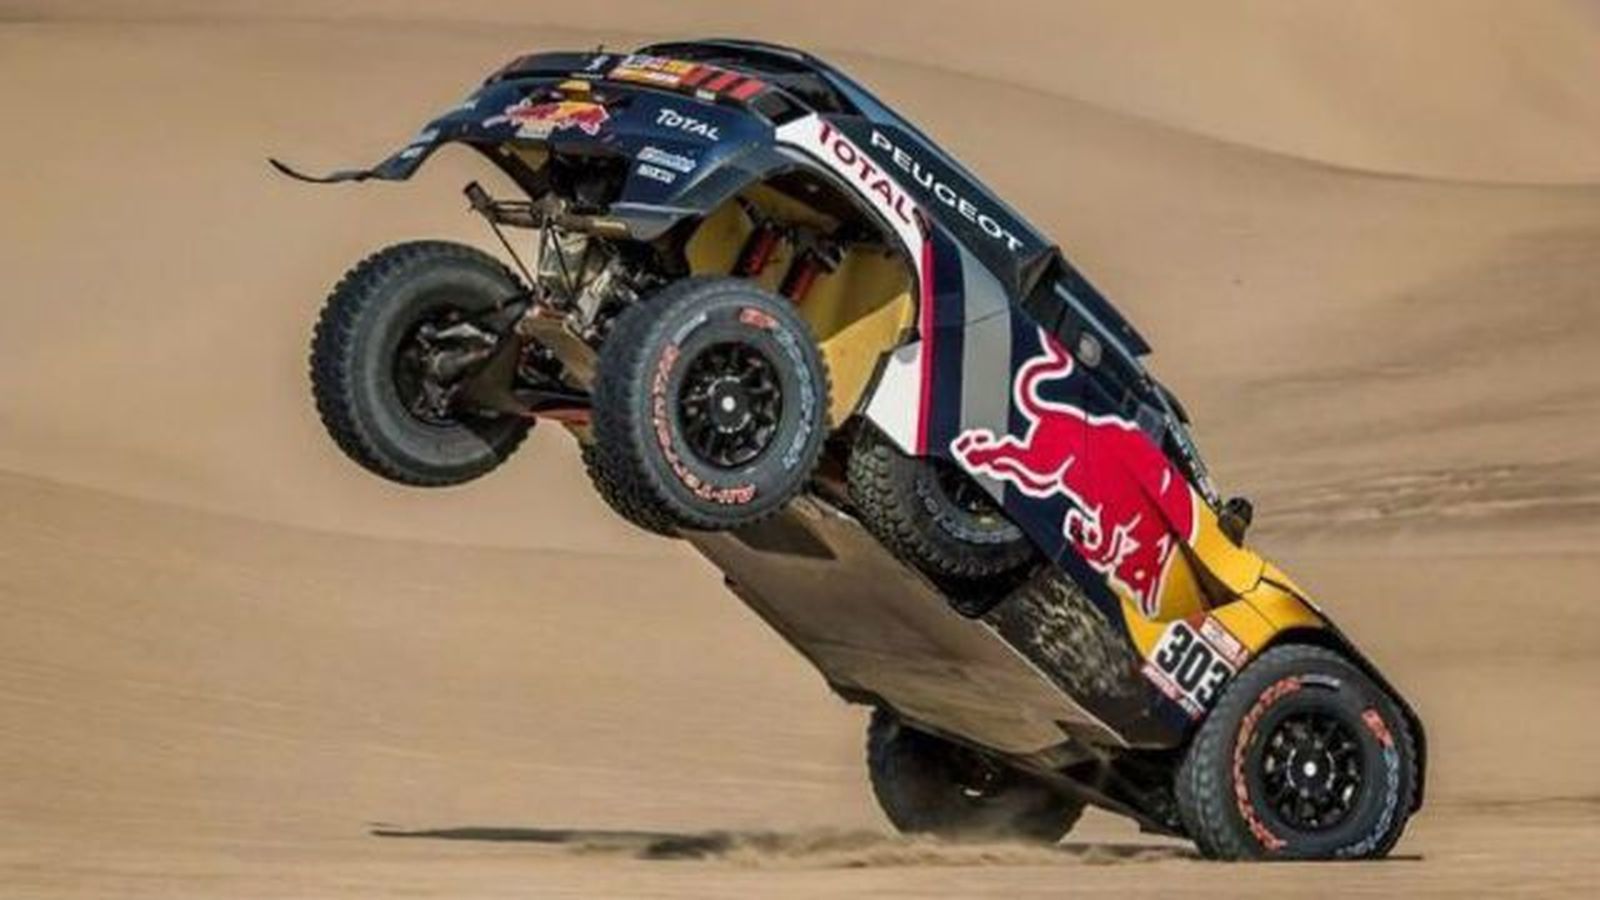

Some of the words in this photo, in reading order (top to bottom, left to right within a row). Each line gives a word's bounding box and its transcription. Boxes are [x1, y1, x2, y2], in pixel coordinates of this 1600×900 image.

[655, 107, 721, 143] TOTAL
[818, 122, 912, 226] TOTAL
[869, 128, 1025, 252] PEUGEOT
[1154, 620, 1232, 713] 303
